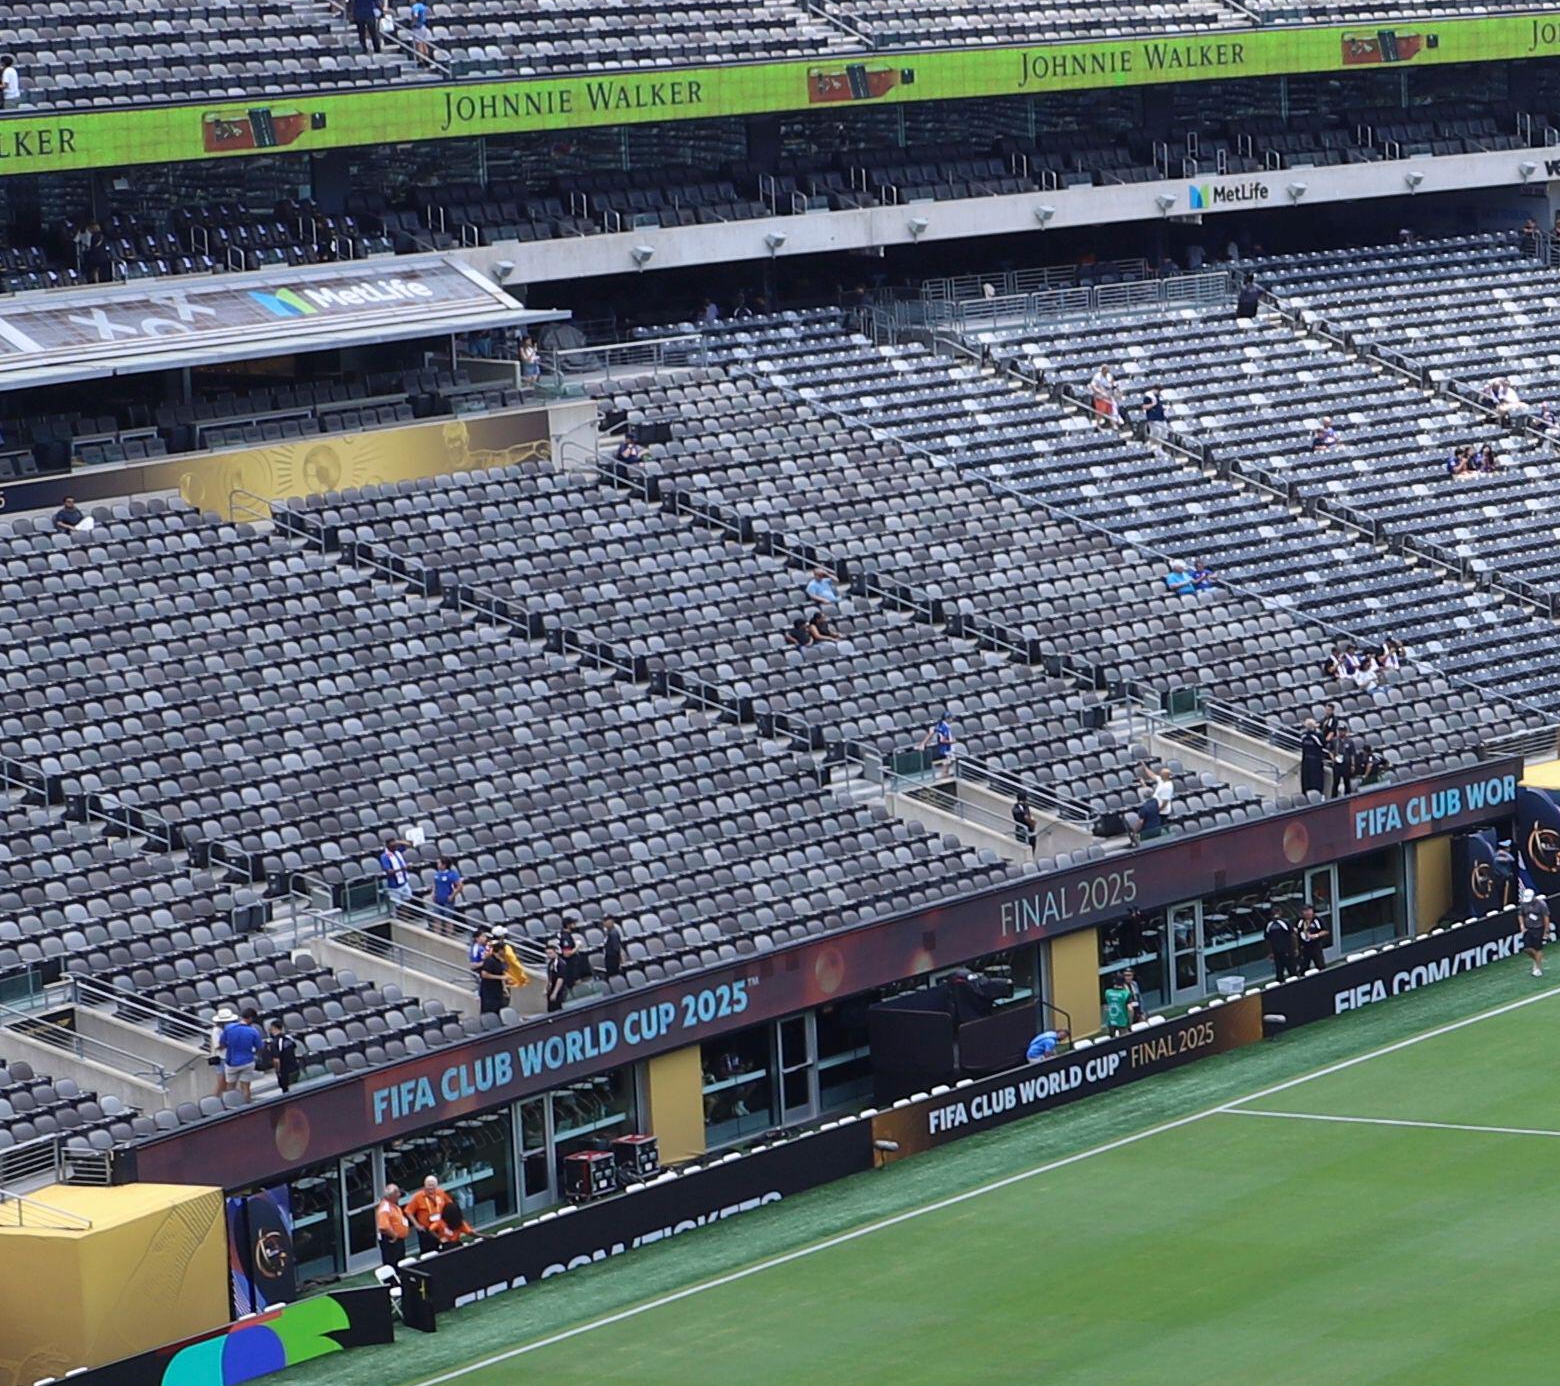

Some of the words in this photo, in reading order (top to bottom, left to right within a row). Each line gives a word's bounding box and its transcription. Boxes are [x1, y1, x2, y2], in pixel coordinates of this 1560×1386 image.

[1018, 43, 1137, 88] JOHNNIE
[1144, 38, 1246, 73] WALKER
[441, 89, 573, 131] JOHNNIE
[586, 80, 704, 113] WALKER
[1213, 182, 1269, 205] MetLife
[304, 280, 432, 307] MetLife
[1355, 805, 1403, 840] FIFA
[1407, 787, 1462, 826] CLUB
[1467, 774, 1516, 814] WOR
[1001, 885, 1074, 937] FINAL
[1080, 867, 1138, 913] 2025
[373, 1077, 436, 1125] FIFA
[440, 1051, 512, 1102] CLUB
[518, 1019, 618, 1079] WORLD
[624, 1006, 678, 1045] CUP
[930, 1102, 969, 1135] FIFA
[971, 1091, 1017, 1121] CLUB
[1019, 1067, 1083, 1105] WORLD
[1131, 1036, 1177, 1069] FINAL
[1178, 1024, 1215, 1053] 2025
